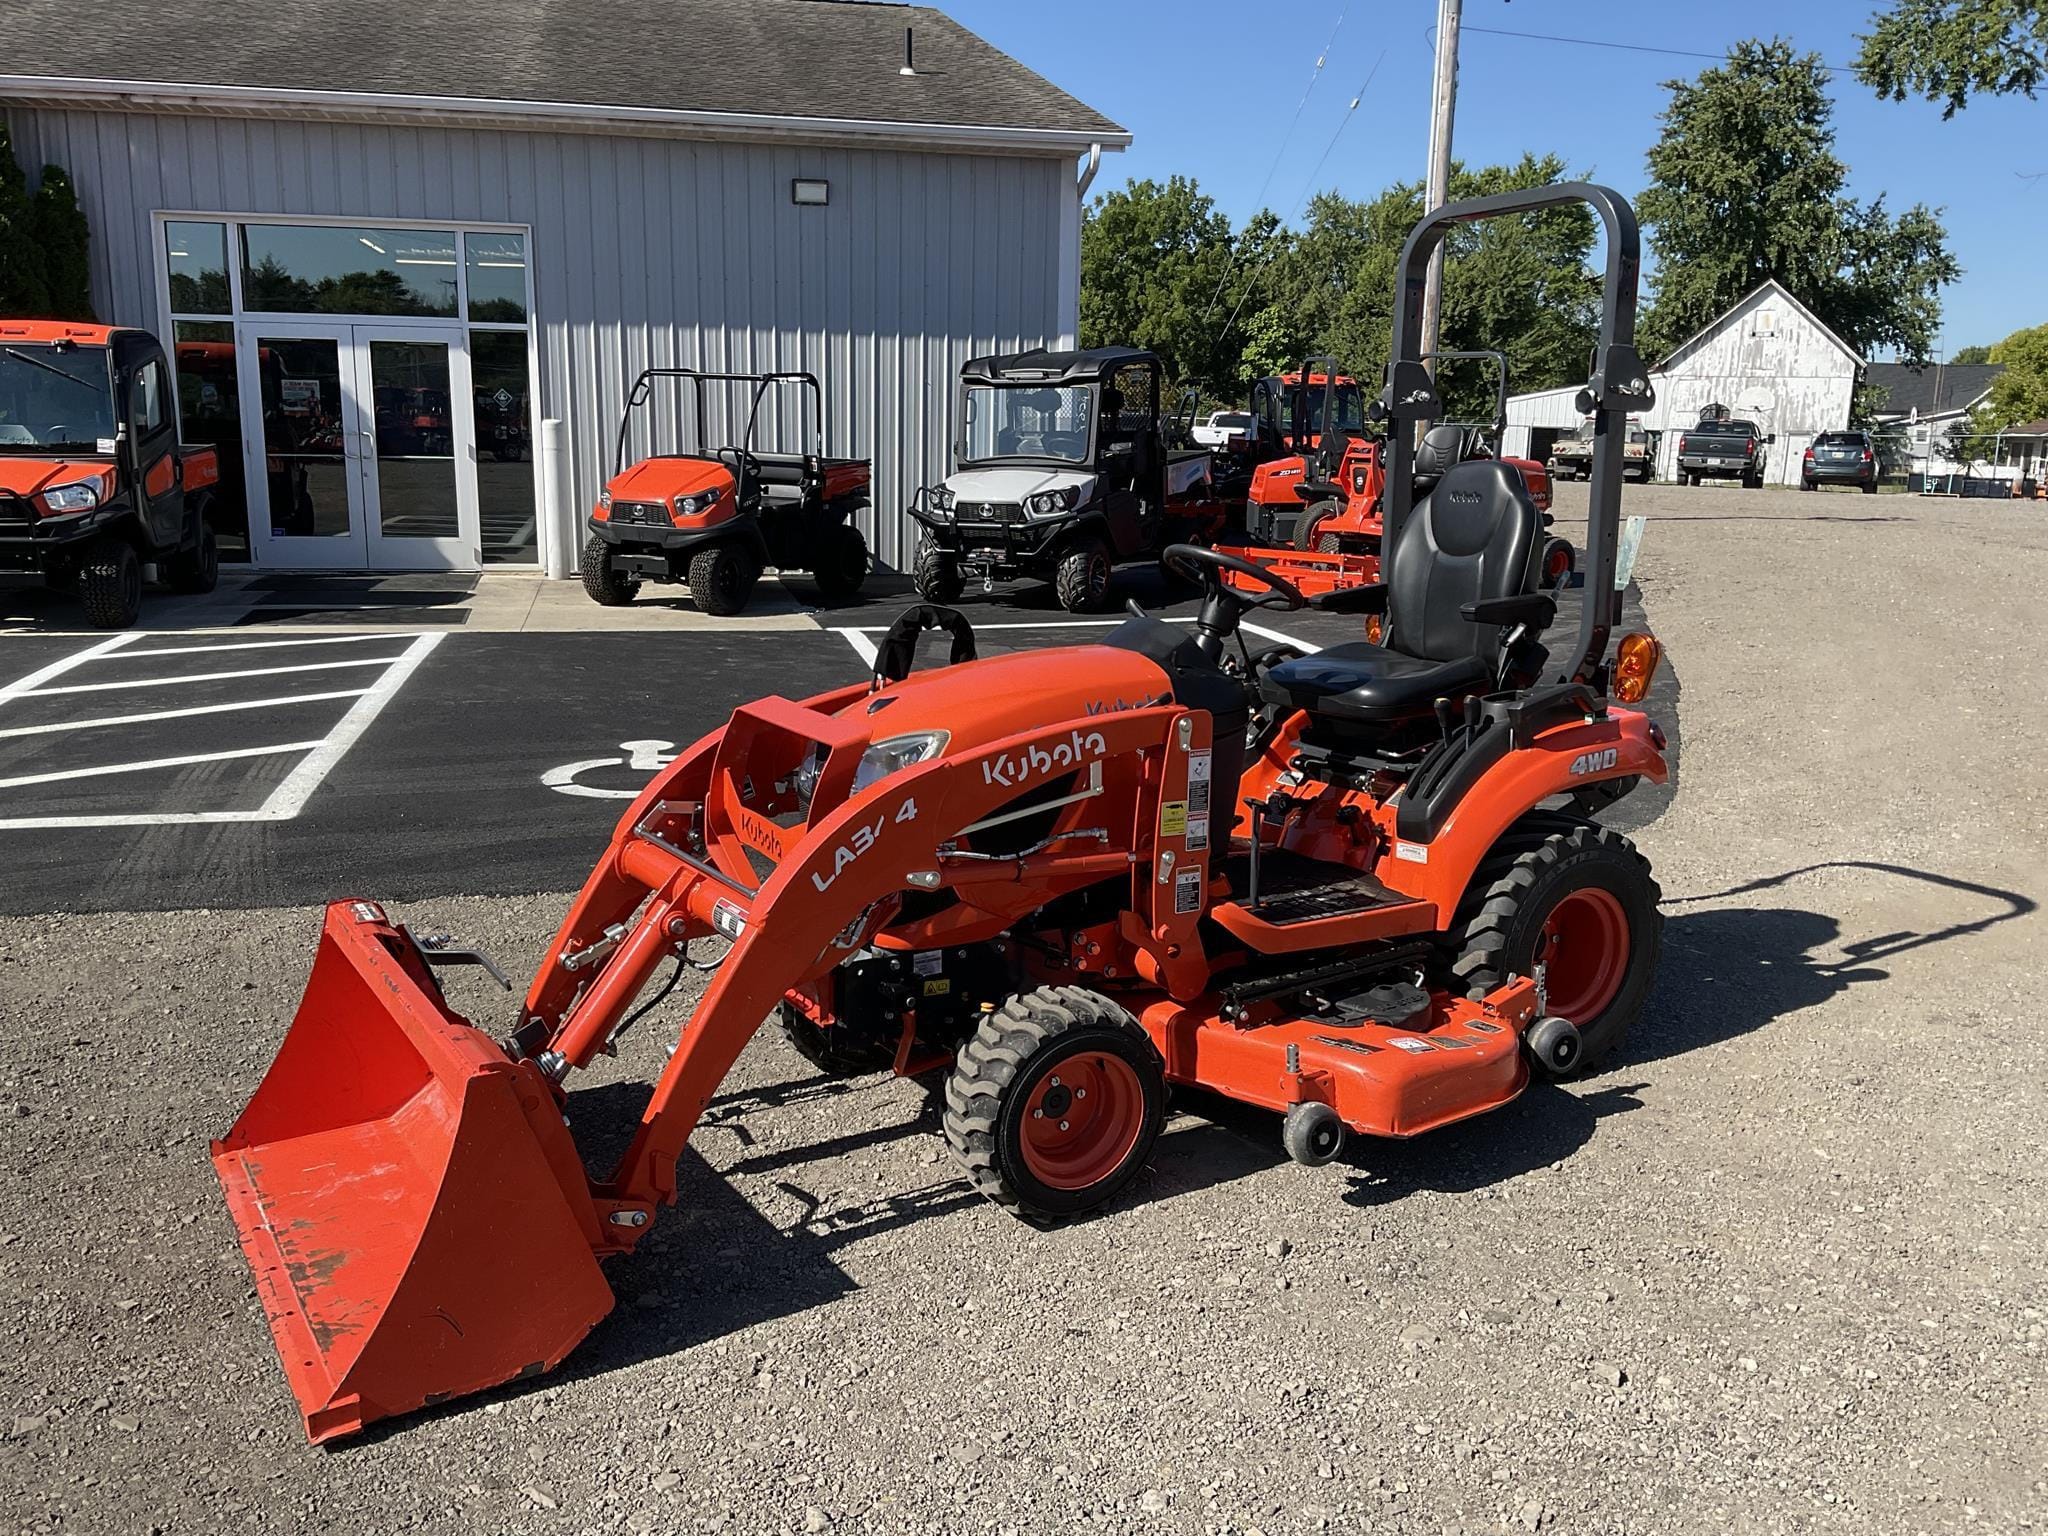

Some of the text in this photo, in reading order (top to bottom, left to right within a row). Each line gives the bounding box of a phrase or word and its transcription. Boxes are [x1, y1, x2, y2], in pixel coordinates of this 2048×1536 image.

[982, 730, 1106, 787] Kubota
[1570, 748, 1617, 775] 4WD
[741, 813, 782, 859] Kubota
